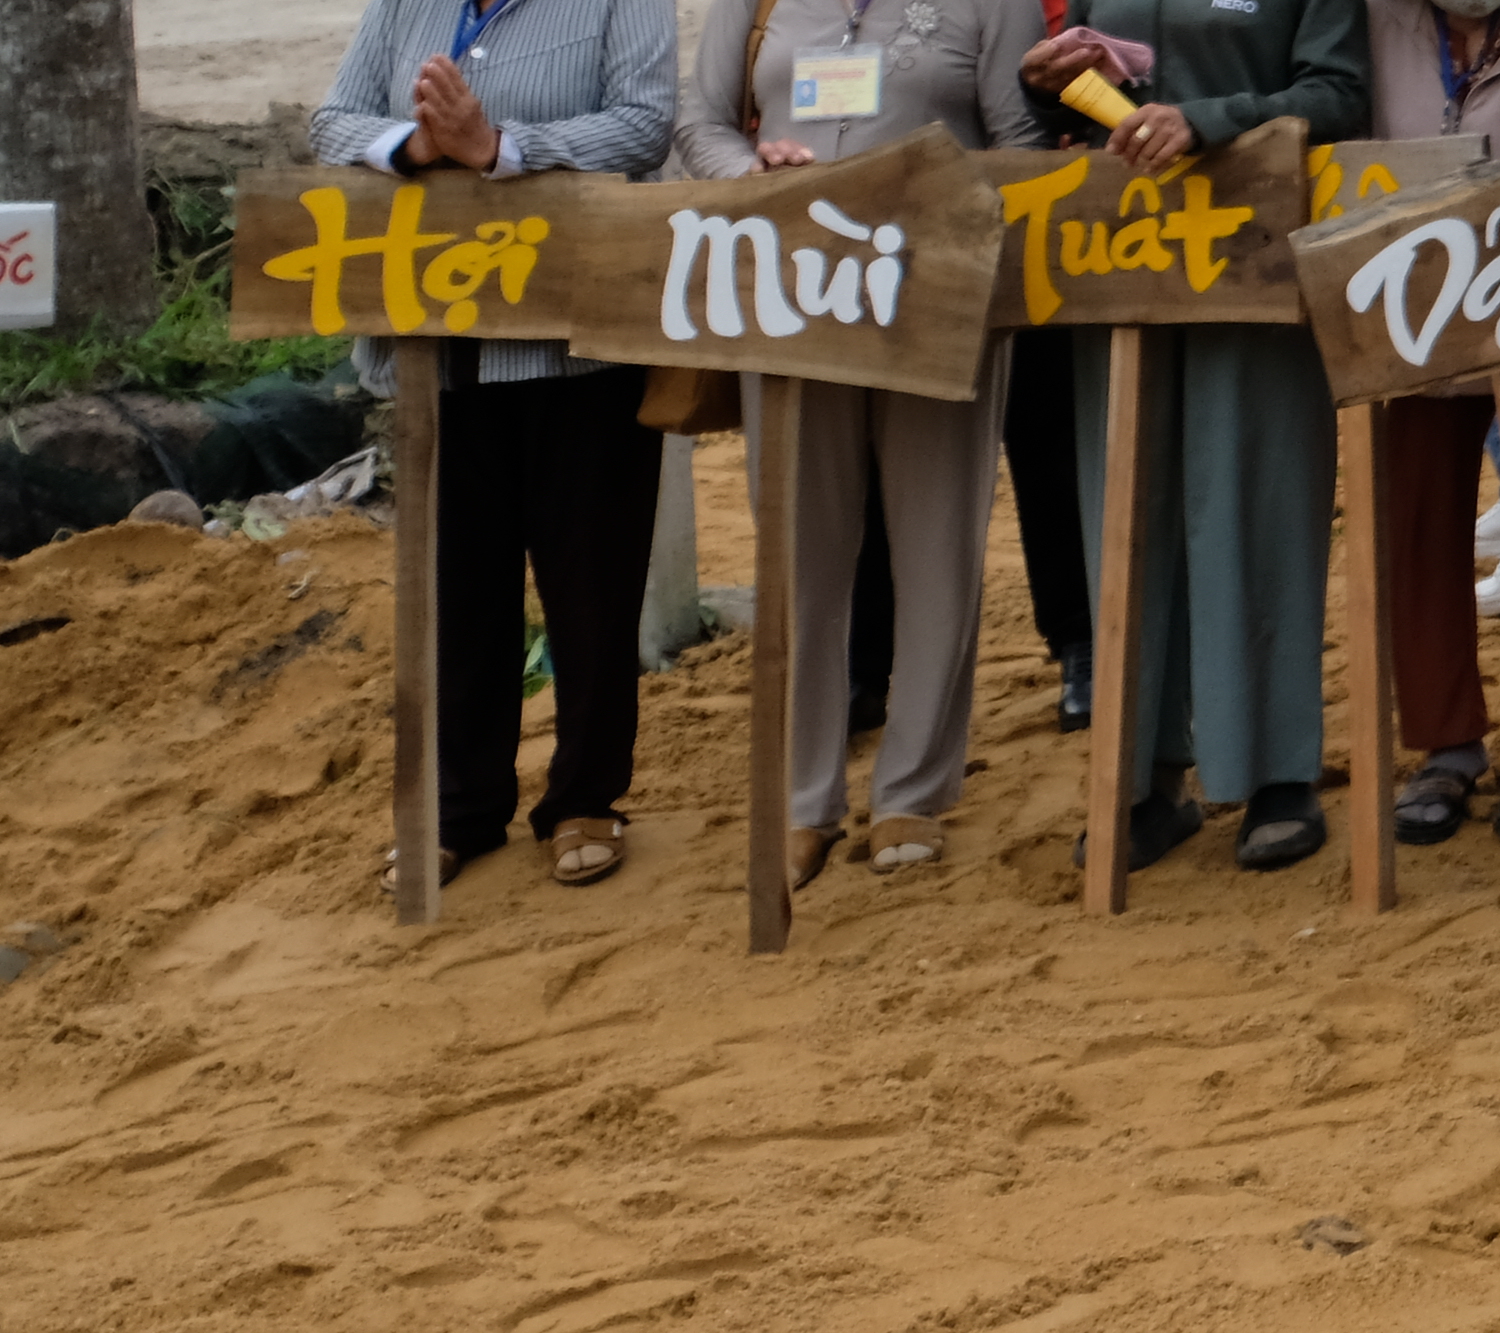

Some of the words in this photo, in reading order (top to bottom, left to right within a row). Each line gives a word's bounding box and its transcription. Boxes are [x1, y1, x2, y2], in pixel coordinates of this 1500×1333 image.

[262, 185, 550, 334] Hợi
[660, 199, 903, 341] Mùi
[1000, 155, 1253, 326] Tuất
